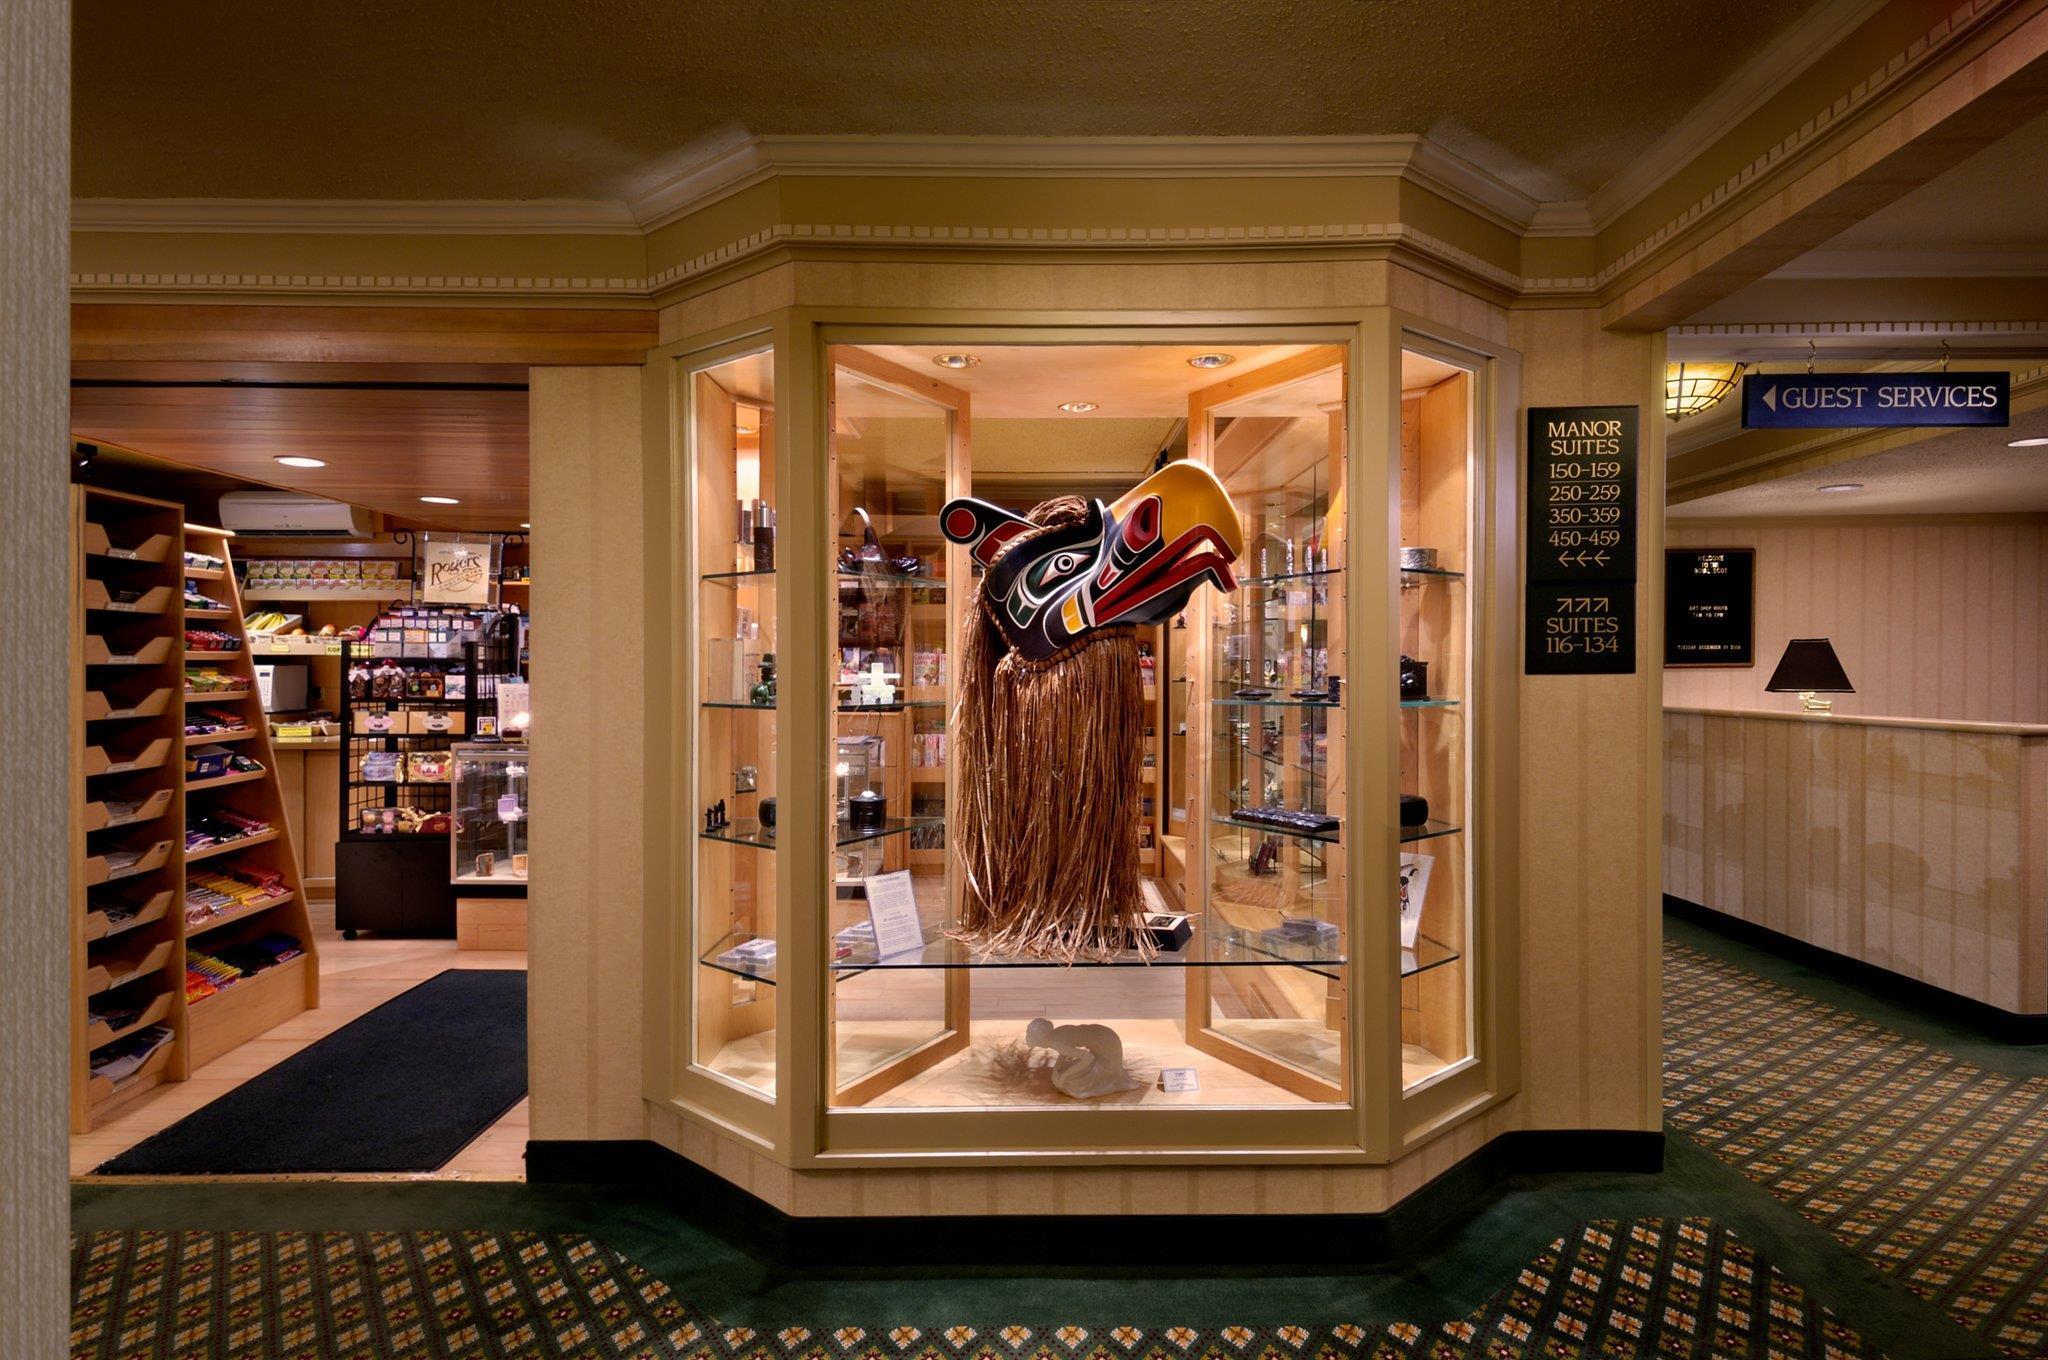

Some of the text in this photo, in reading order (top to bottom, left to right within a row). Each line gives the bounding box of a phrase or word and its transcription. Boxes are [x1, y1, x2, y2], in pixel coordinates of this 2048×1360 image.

[1782, 385, 1998, 409] GUEST SERVICES
[1547, 420, 1622, 438] MANOR
[1550, 438, 1620, 456] SUITES
[1549, 461, 1621, 479] 150-159
[1548, 484, 1621, 502] 250-259
[1548, 507, 1621, 524] 350-359
[1548, 529, 1621, 547] 450-459
[1546, 616, 1619, 634] SUITES
[1545, 635, 1620, 654] 116-134
